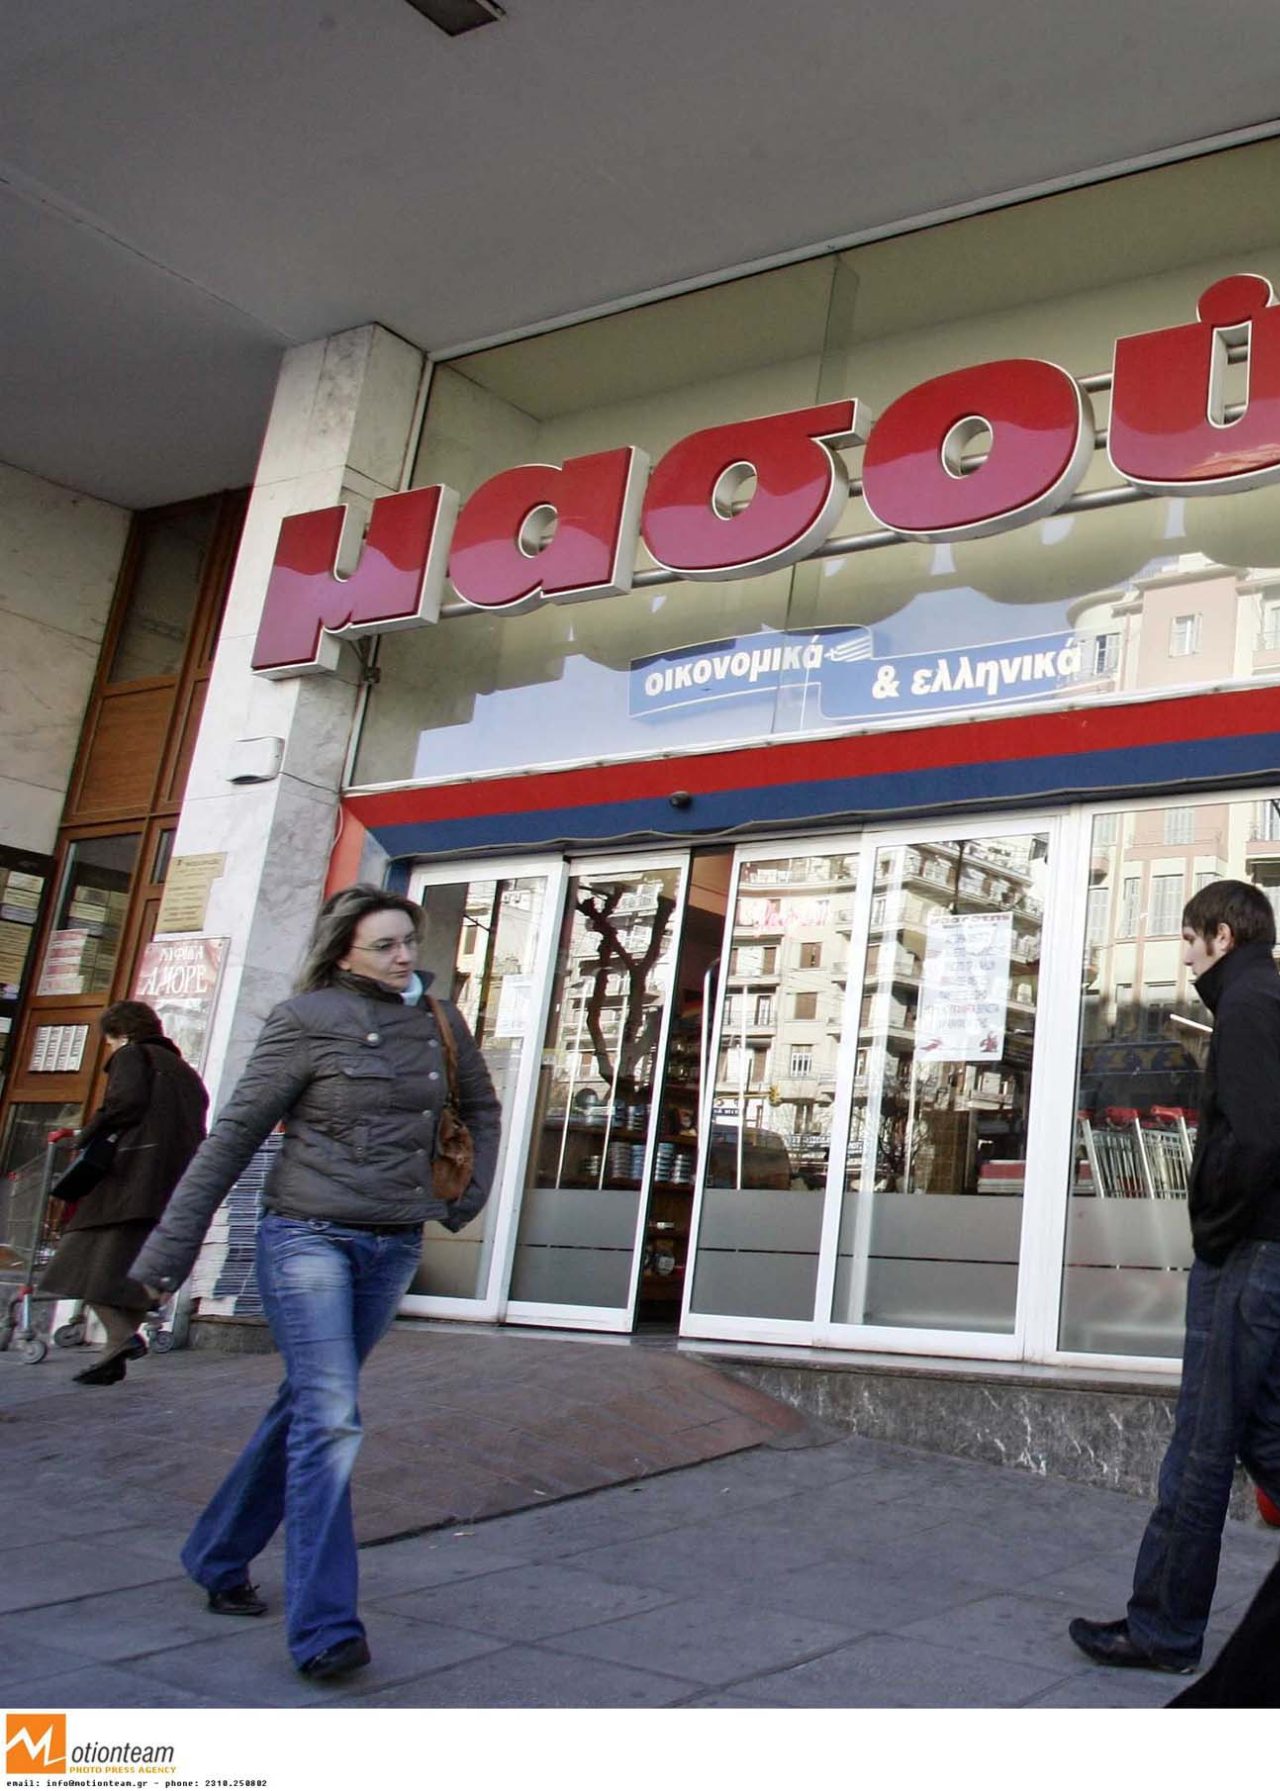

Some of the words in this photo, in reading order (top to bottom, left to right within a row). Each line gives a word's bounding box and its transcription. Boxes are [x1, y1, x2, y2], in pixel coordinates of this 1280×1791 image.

[643, 635, 825, 698] οικονομικά
[870, 665, 900, 701] &
[910, 638, 1085, 696] ελληνικά
